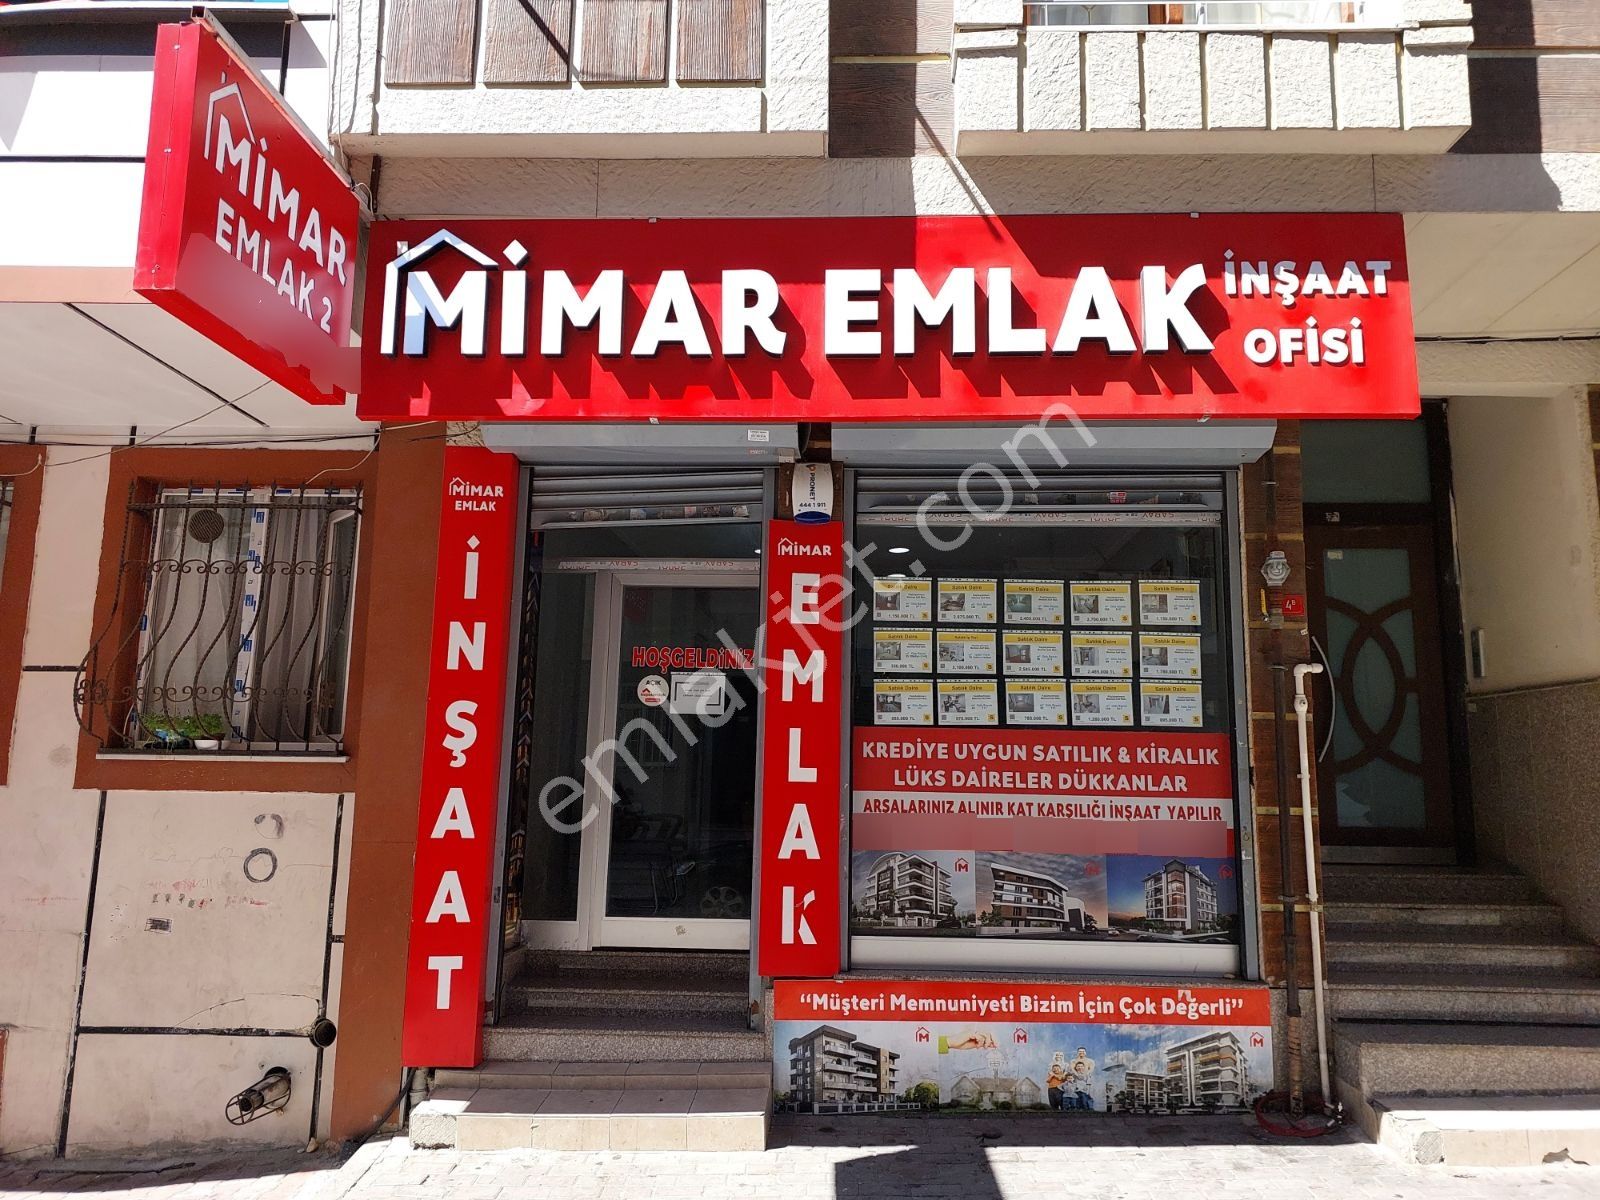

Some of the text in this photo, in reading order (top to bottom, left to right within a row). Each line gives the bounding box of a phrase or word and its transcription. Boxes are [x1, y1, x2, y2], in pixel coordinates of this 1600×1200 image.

[212, 113, 347, 286] MİMAR
[215, 197, 332, 334] EMLAK 2
[1224, 249, 1391, 306] İNŞAAT
[402, 239, 1215, 358] MİMAR EMLAK
[1244, 316, 1365, 365] OFİSİ
[452, 482, 504, 497] MİMAR
[455, 500, 497, 512] EMLAK
[781, 542, 832, 556] MİMAR
[777, 572, 825, 945] EMLAK
[862, 738, 1219, 765] KREDİYE UYGUN SATILIK & KİRALIK
[425, 535, 488, 1010] İNŞAAT
[894, 765, 1188, 792] LÜKS DAİRELER DÜKKANLAR
[863, 799, 1222, 821] ARSALARINIZ ALINIR KAT KARŞILIĞI İNŞAAT YAPILIR
[800, 993, 885, 1016] “Müşteri
[890, 993, 1015, 1016] Memnuniyeti
[1020, 994, 1073, 1013] Bizim
[1079, 991, 1115, 1019] İçin
[1119, 997, 1157, 1020] Çok
